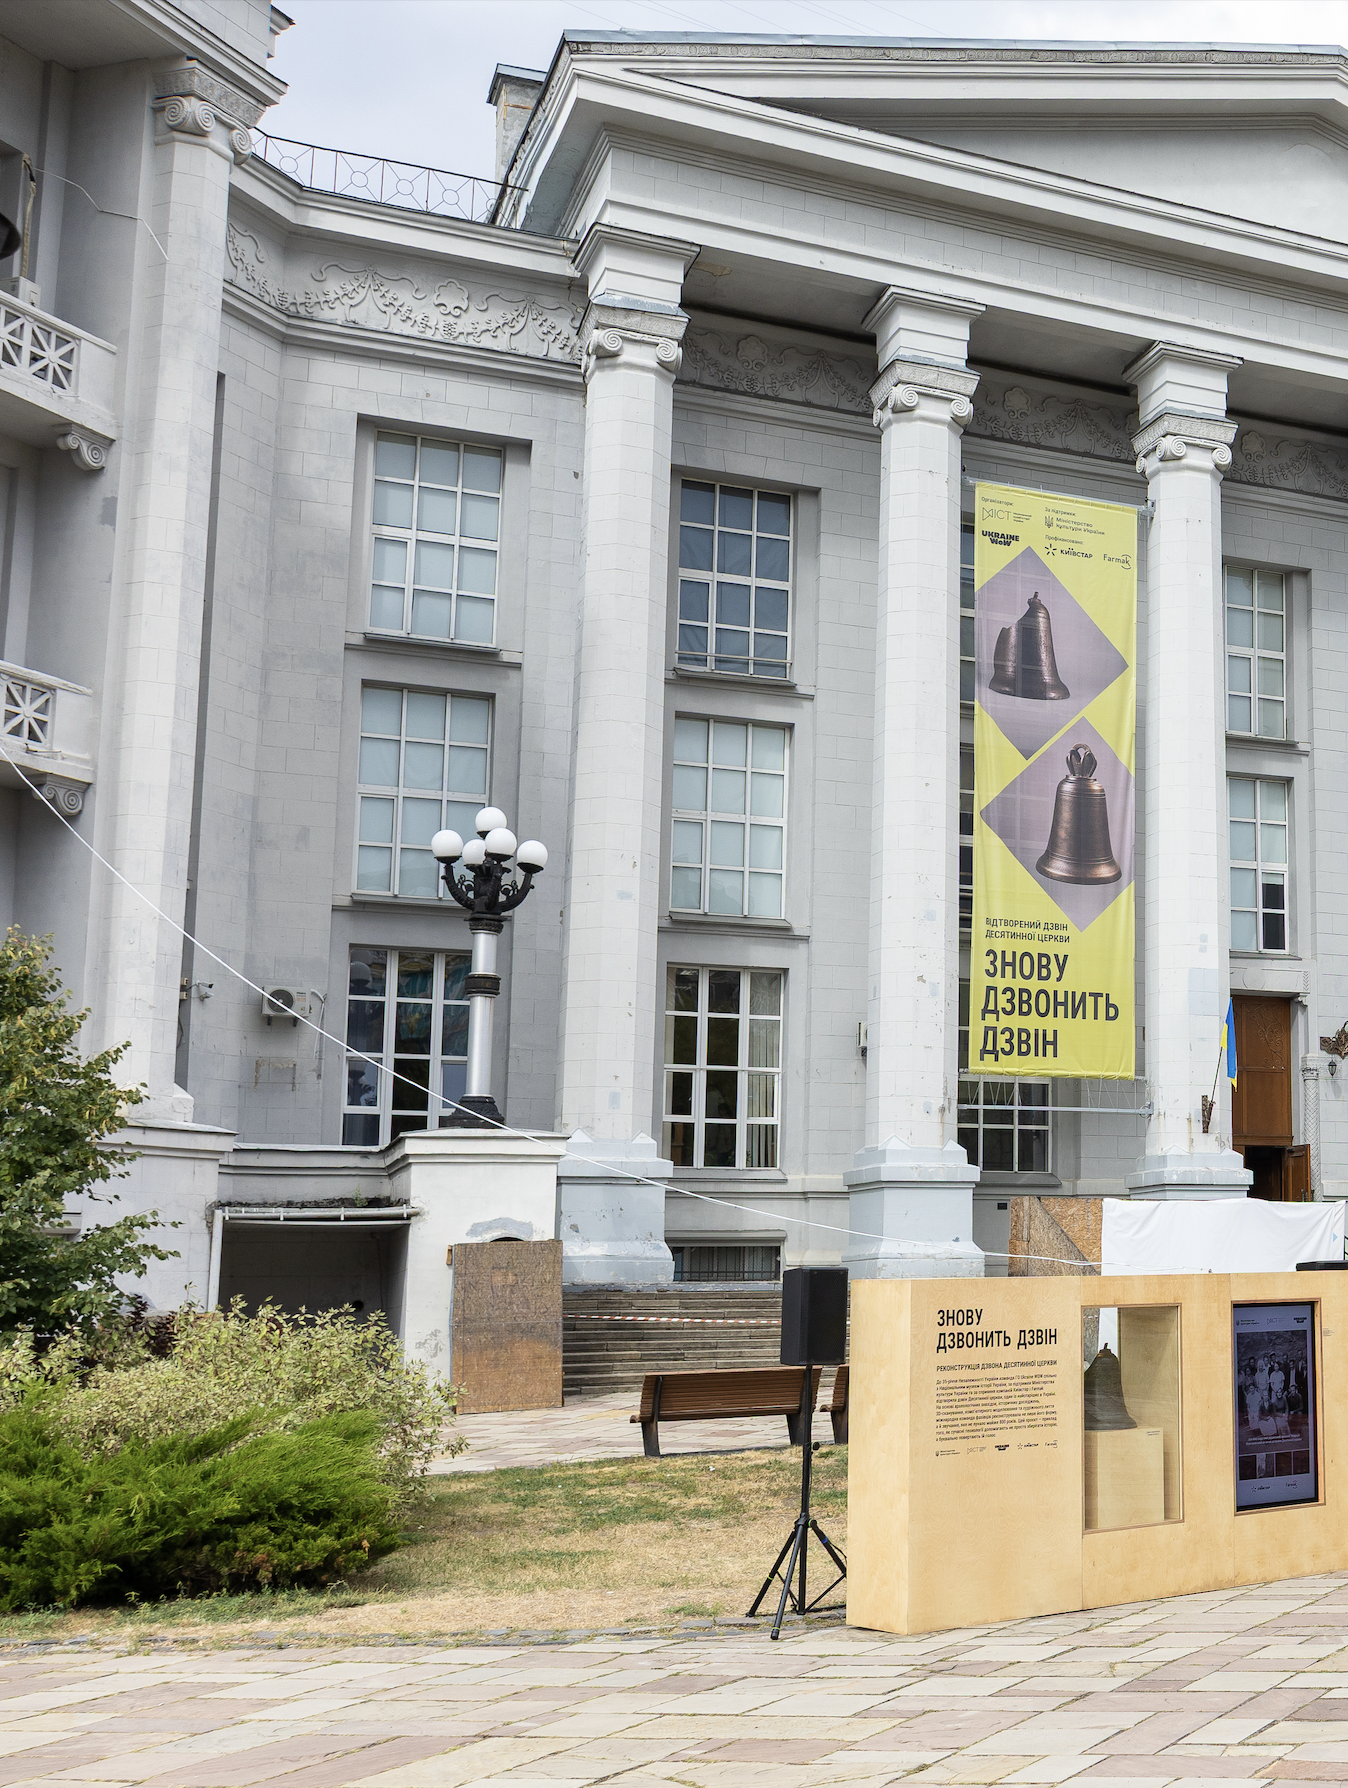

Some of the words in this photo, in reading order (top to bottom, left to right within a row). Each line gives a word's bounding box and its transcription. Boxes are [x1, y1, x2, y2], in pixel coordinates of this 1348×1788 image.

[1055, 523, 1082, 532] культури
[1083, 527, 1105, 535] України
[1056, 517, 1093, 528] Міністерство
[982, 530, 1020, 542] UKRAINE
[1103, 553, 1132, 567] Farmak
[985, 917, 1041, 930] ВІДТВОРЕНИЙ
[1043, 922, 1068, 932] ДЗВІН
[985, 929, 1036, 941] ДЕСЯТИННОЇ
[1038, 933, 1070, 943] ЦЕРКВИ
[984, 948, 1069, 982] ЗНОВУ
[981, 985, 1119, 1022] ДЗВОНИТЬ
[979, 1026, 1058, 1062] ДЗВІН
[937, 1308, 983, 1327] ЗНОВУ
[936, 1330, 1011, 1353] ДЗВОНИТЬ
[1017, 1328, 1057, 1350] ДЗВІН
[937, 1363, 980, 1372] РЕКОНСТРУКЦІЯ
[1003, 1360, 1036, 1368] ДЕСЯТИННОЇ
